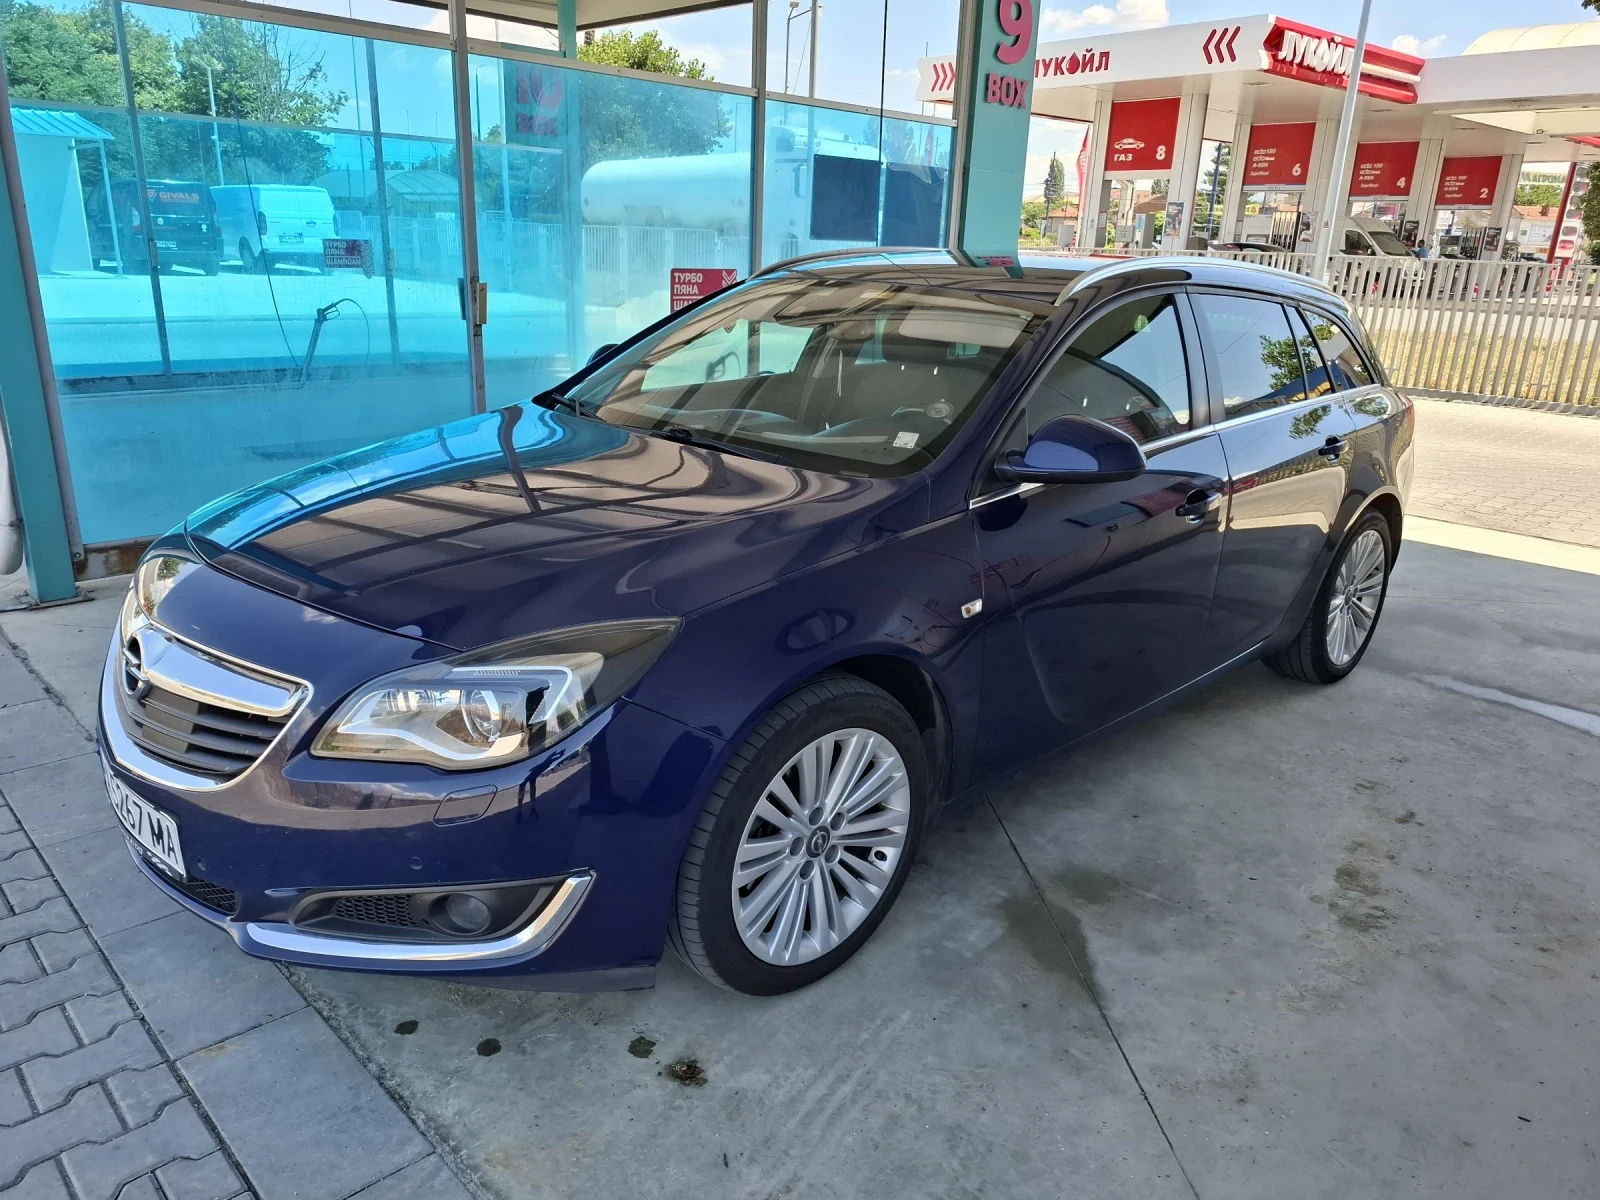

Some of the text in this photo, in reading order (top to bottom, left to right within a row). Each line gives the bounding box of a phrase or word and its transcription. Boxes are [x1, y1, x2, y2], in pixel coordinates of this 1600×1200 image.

[997, 0, 1033, 64] 9
[987, 73, 1029, 109] BOX
[1114, 153, 1133, 161] ГАЗ
[1156, 145, 1166, 160] 8
[1292, 163, 1301, 176] 6
[1396, 177, 1406, 188] 4
[159, 191, 199, 200] GIVALS
[1479, 188, 1489, 198] 2
[673, 273, 703, 283] ТУРБО
[674, 284, 699, 295] ПЯНА
